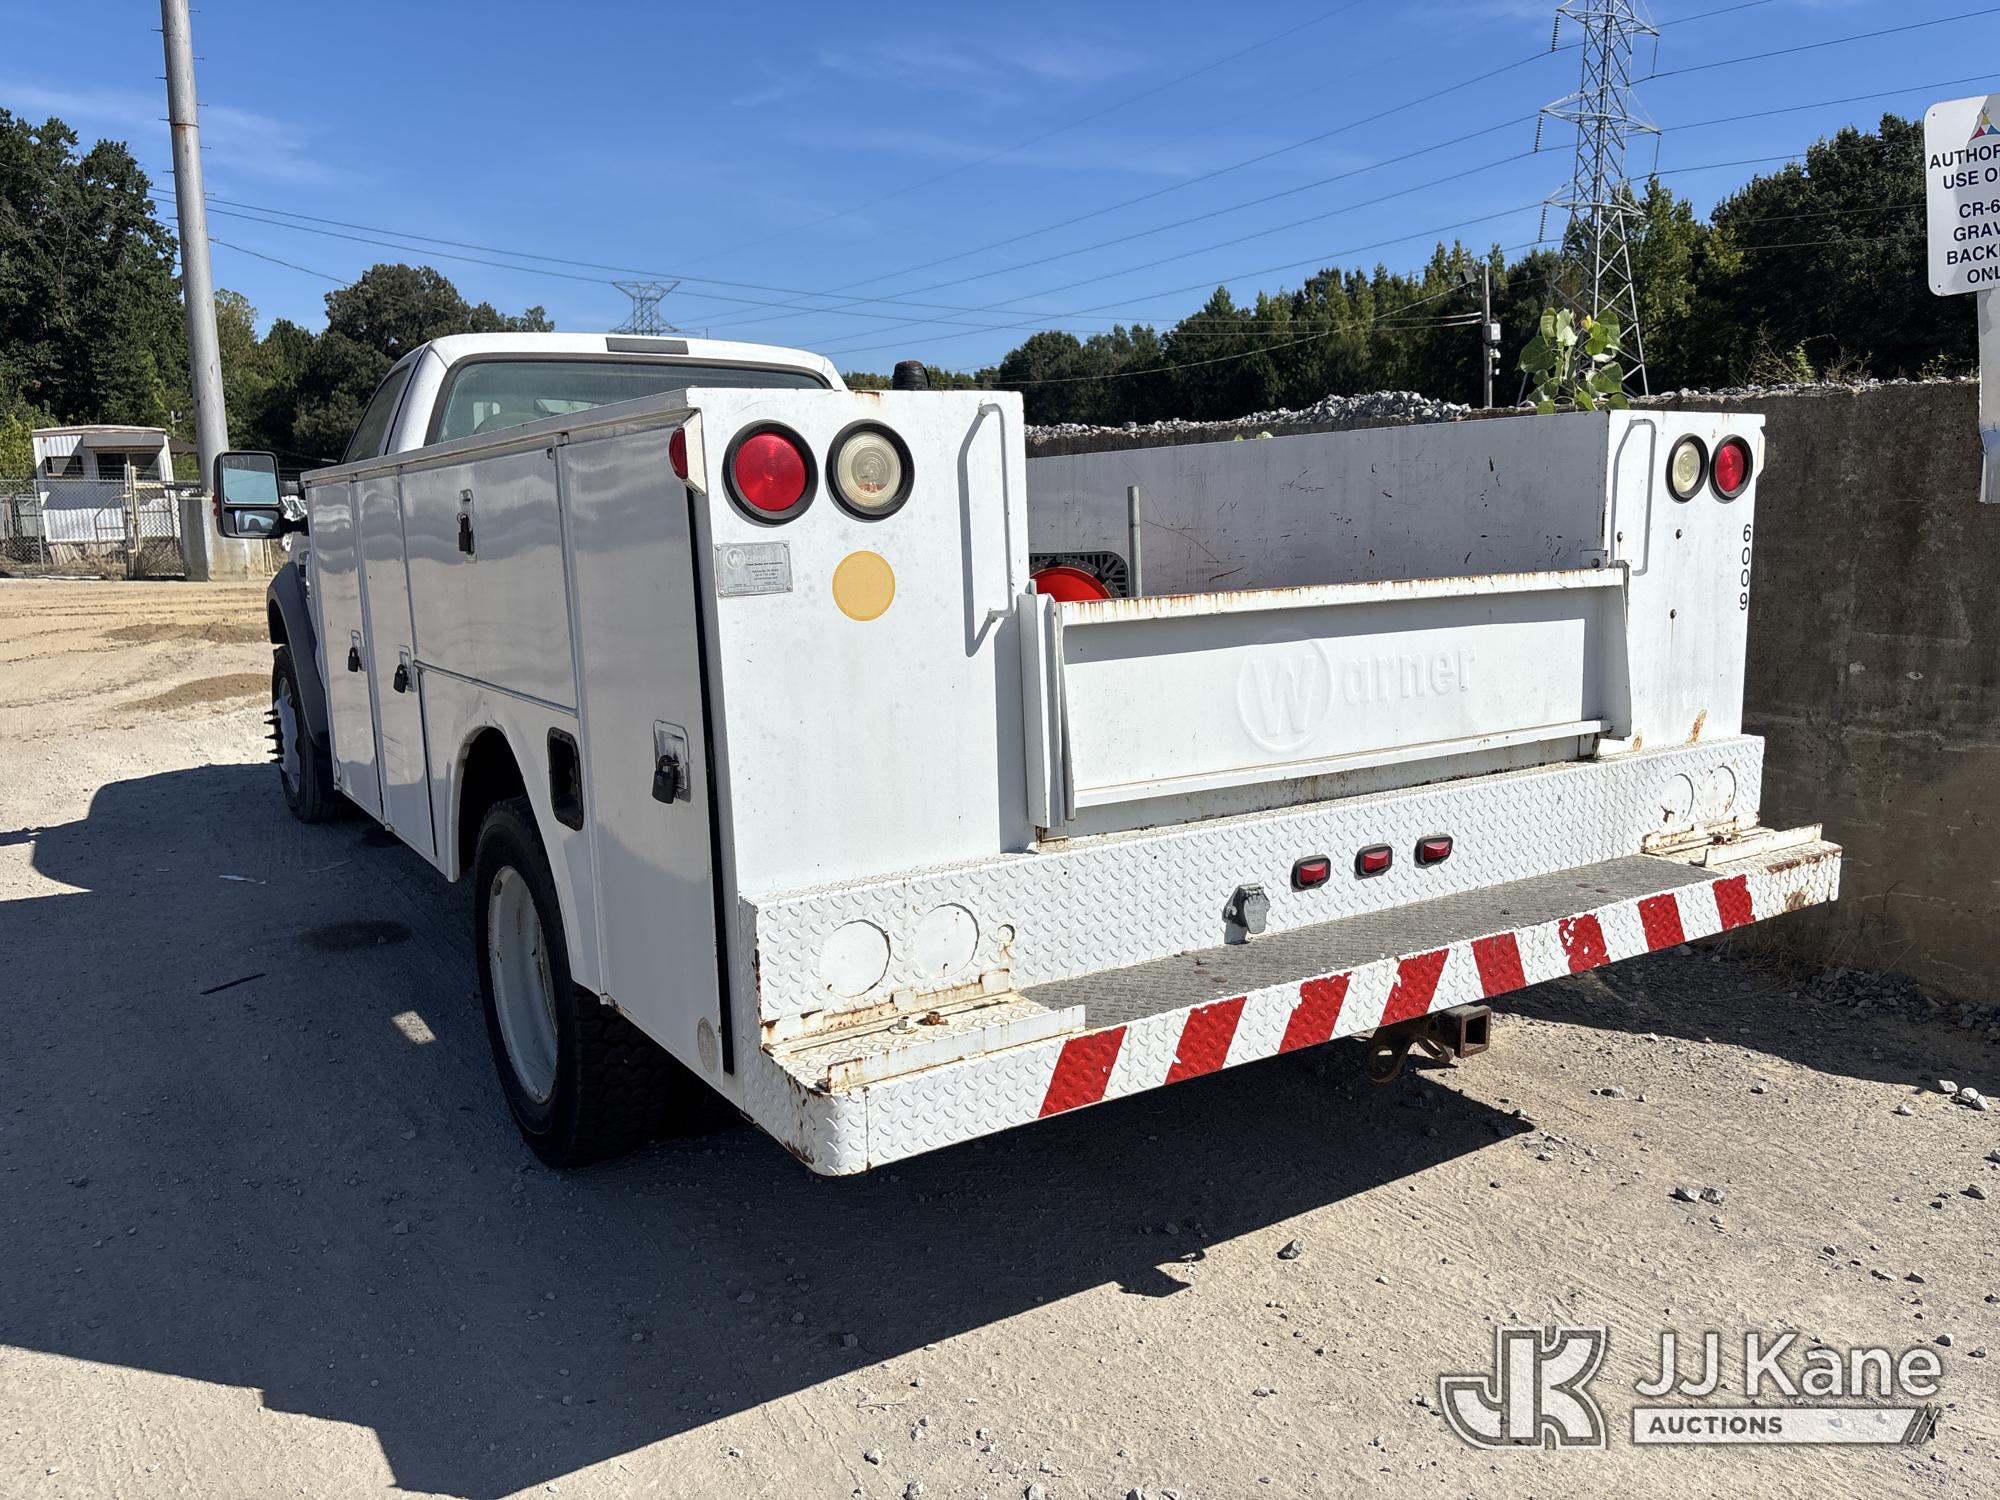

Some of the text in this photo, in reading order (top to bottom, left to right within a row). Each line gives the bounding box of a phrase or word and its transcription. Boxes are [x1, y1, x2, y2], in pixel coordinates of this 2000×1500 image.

[1943, 167, 2000, 189] USE O
[1946, 243, 2000, 265] BACK
[1739, 523, 1752, 611] 6009
[1250, 647, 1477, 739] Warner
